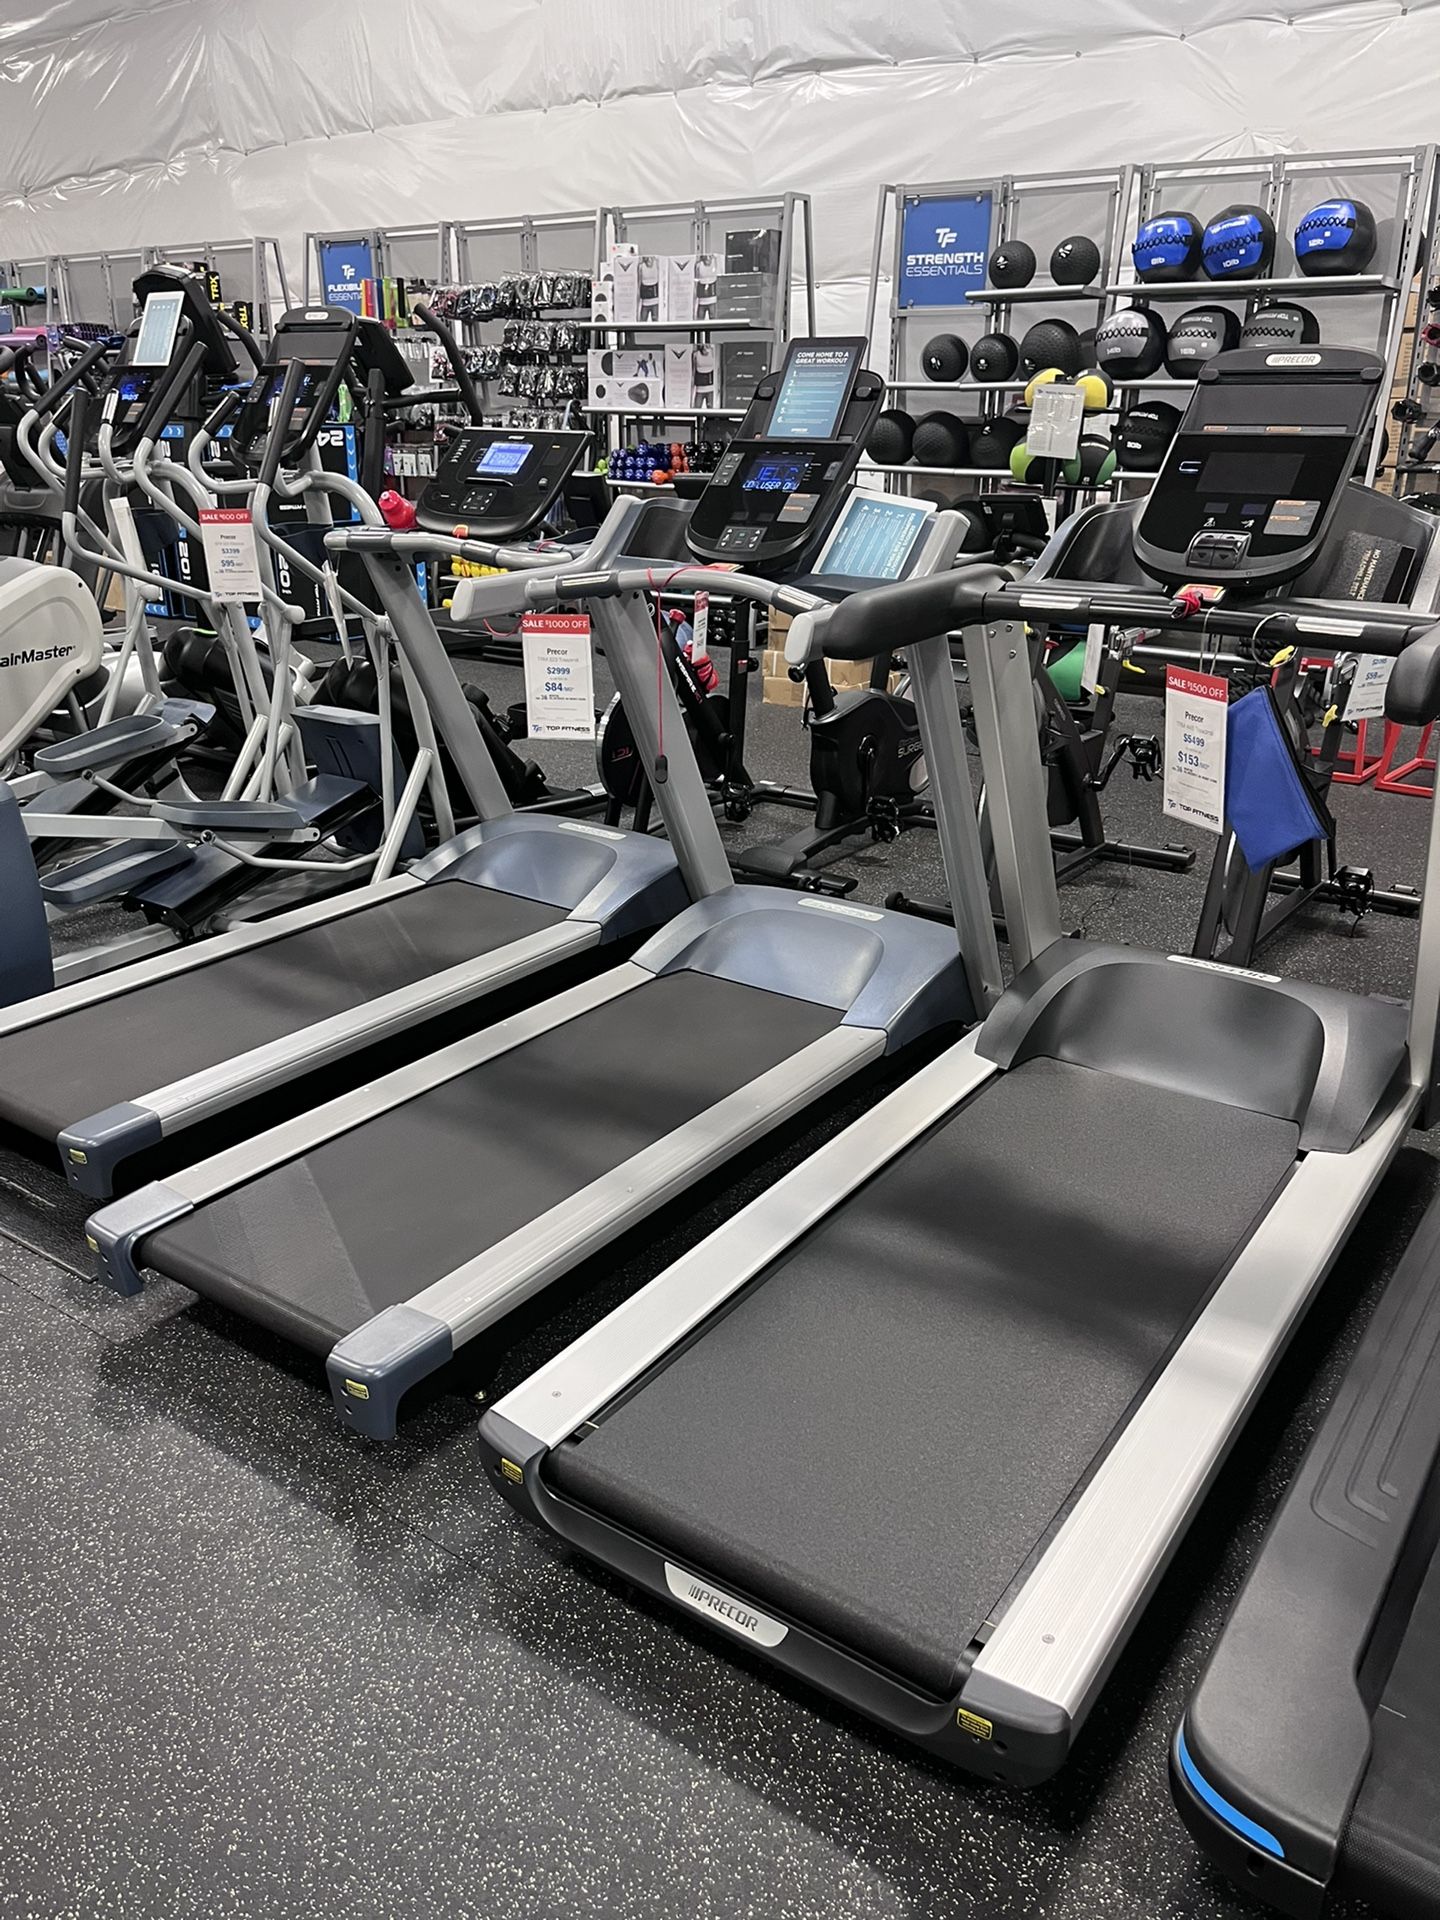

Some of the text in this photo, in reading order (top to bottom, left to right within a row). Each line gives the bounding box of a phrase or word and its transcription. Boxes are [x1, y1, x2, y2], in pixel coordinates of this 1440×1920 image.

[936, 228, 958, 248] TF
[906, 252, 984, 266] STRENGTH
[342, 264, 355, 280] TF
[906, 264, 983, 277] ESSENTIALS
[209, 275, 220, 300] TRX
[238, 305, 249, 329] TRX
[1278, 355, 1316, 364] PRECOR
[1372, 548, 1382, 559] NO
[220, 560, 235, 568] $95
[522, 620, 588, 628] SALE $1000 OFF
[546, 648, 568, 656] Precor
[546, 666, 570, 675] $2999
[544, 682, 563, 692] $84
[1168, 676, 1224, 698] SALE $1500 OFF
[1185, 711, 1204, 723] Precor
[1184, 733, 1205, 747] $5499
[1178, 750, 1199, 767] $153
[1179, 803, 1192, 812] TOP
[1192, 808, 1219, 822] FITNESS
[698, 1590, 758, 1632] PRECOR
